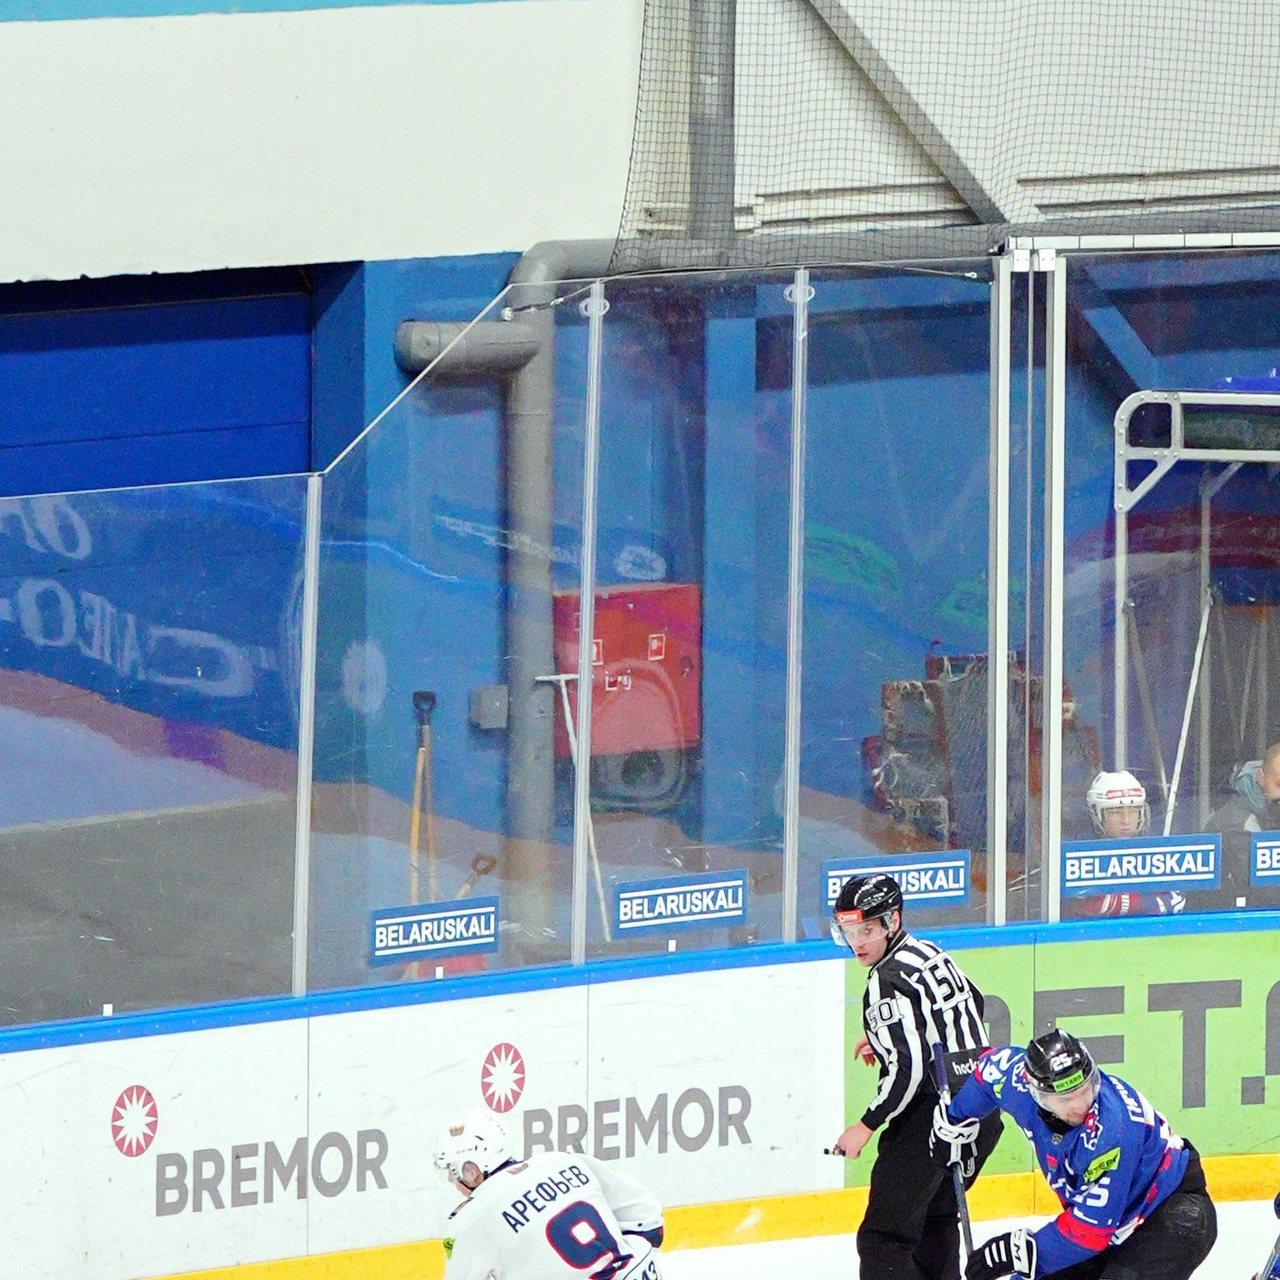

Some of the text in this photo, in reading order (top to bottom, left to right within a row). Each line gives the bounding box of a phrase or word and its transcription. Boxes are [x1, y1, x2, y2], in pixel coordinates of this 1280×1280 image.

[1065, 851, 1215, 880] BELARUSKALI
[827, 867, 964, 899] BUSKALI
[619, 887, 743, 920] BELARUSKALI
[375, 914, 495, 948] BELARUSKALI
[926, 959, 966, 1008] 50
[867, 1000, 894, 1030] 50
[1050, 1052, 1072, 1071] 25
[523, 1083, 752, 1162] BREMOR
[155, 1129, 389, 1217] BREMOR
[501, 1164, 591, 1234] АРЕФЬЕВ
